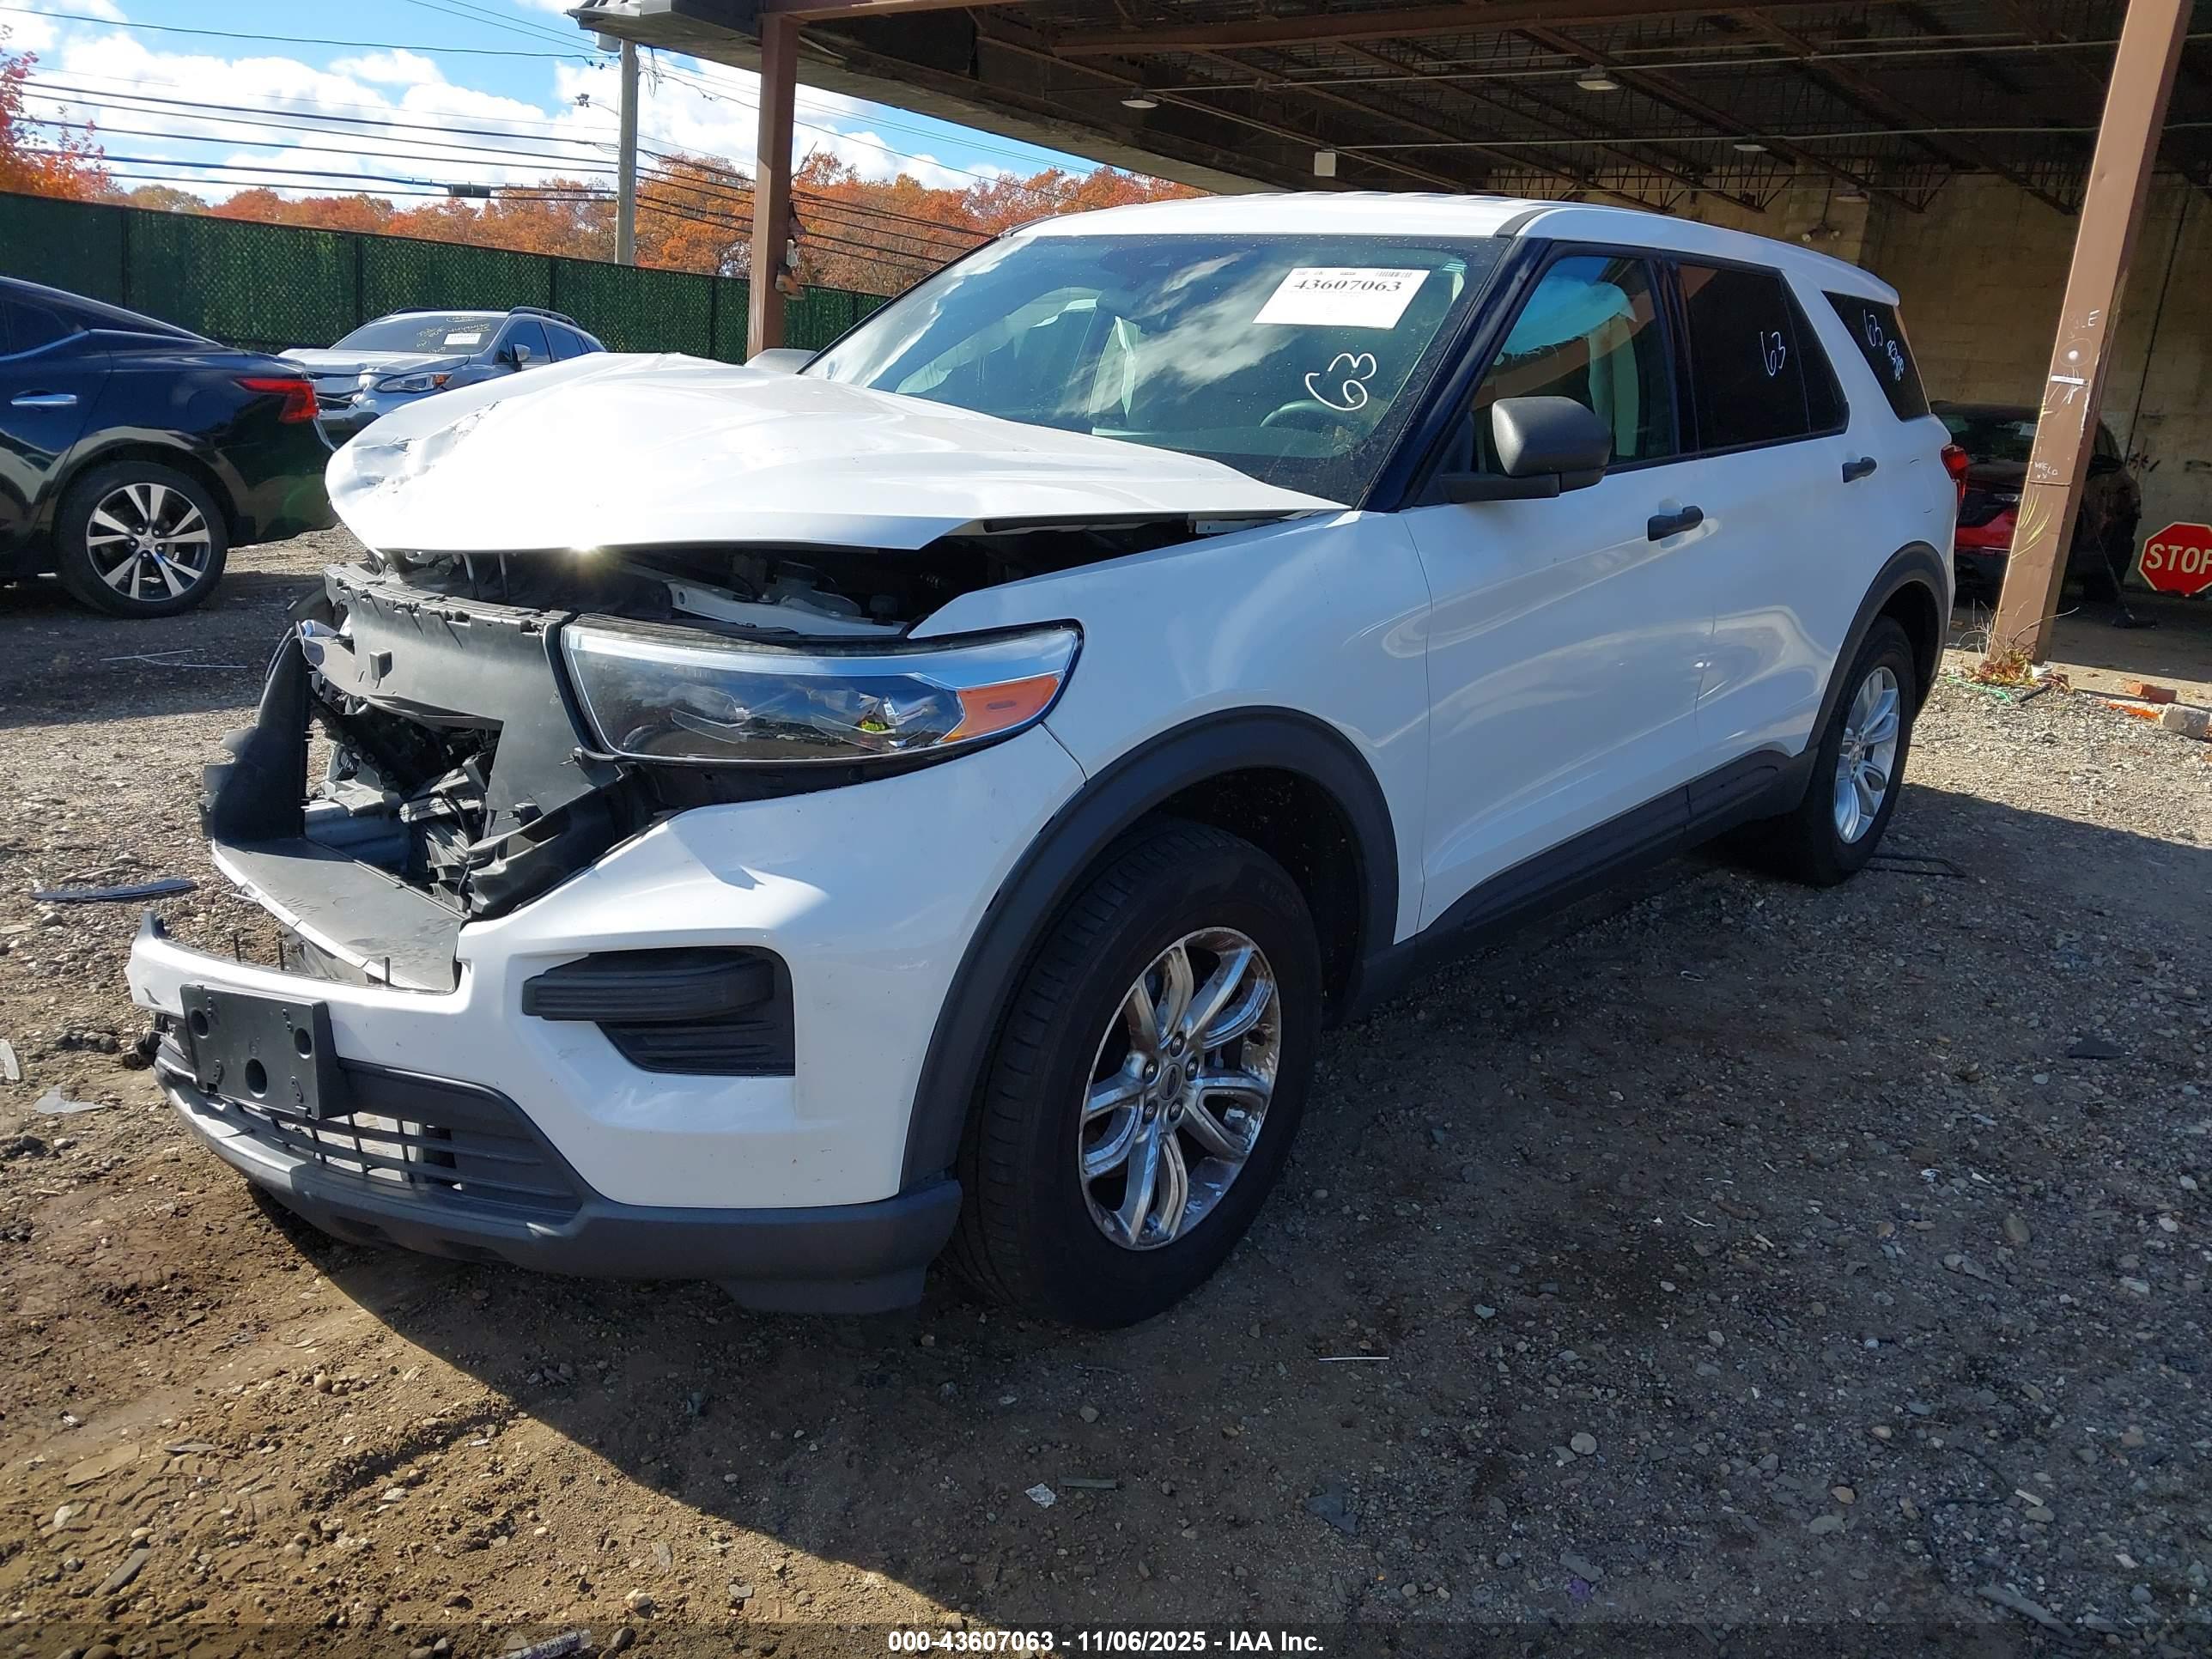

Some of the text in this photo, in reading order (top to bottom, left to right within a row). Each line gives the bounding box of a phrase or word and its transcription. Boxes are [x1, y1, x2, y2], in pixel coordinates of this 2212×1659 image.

[1293, 279, 1401, 291] 43607063
[1863, 308, 1883, 347] 63
[1760, 331, 1786, 376] 63
[1304, 352, 1377, 410] 63
